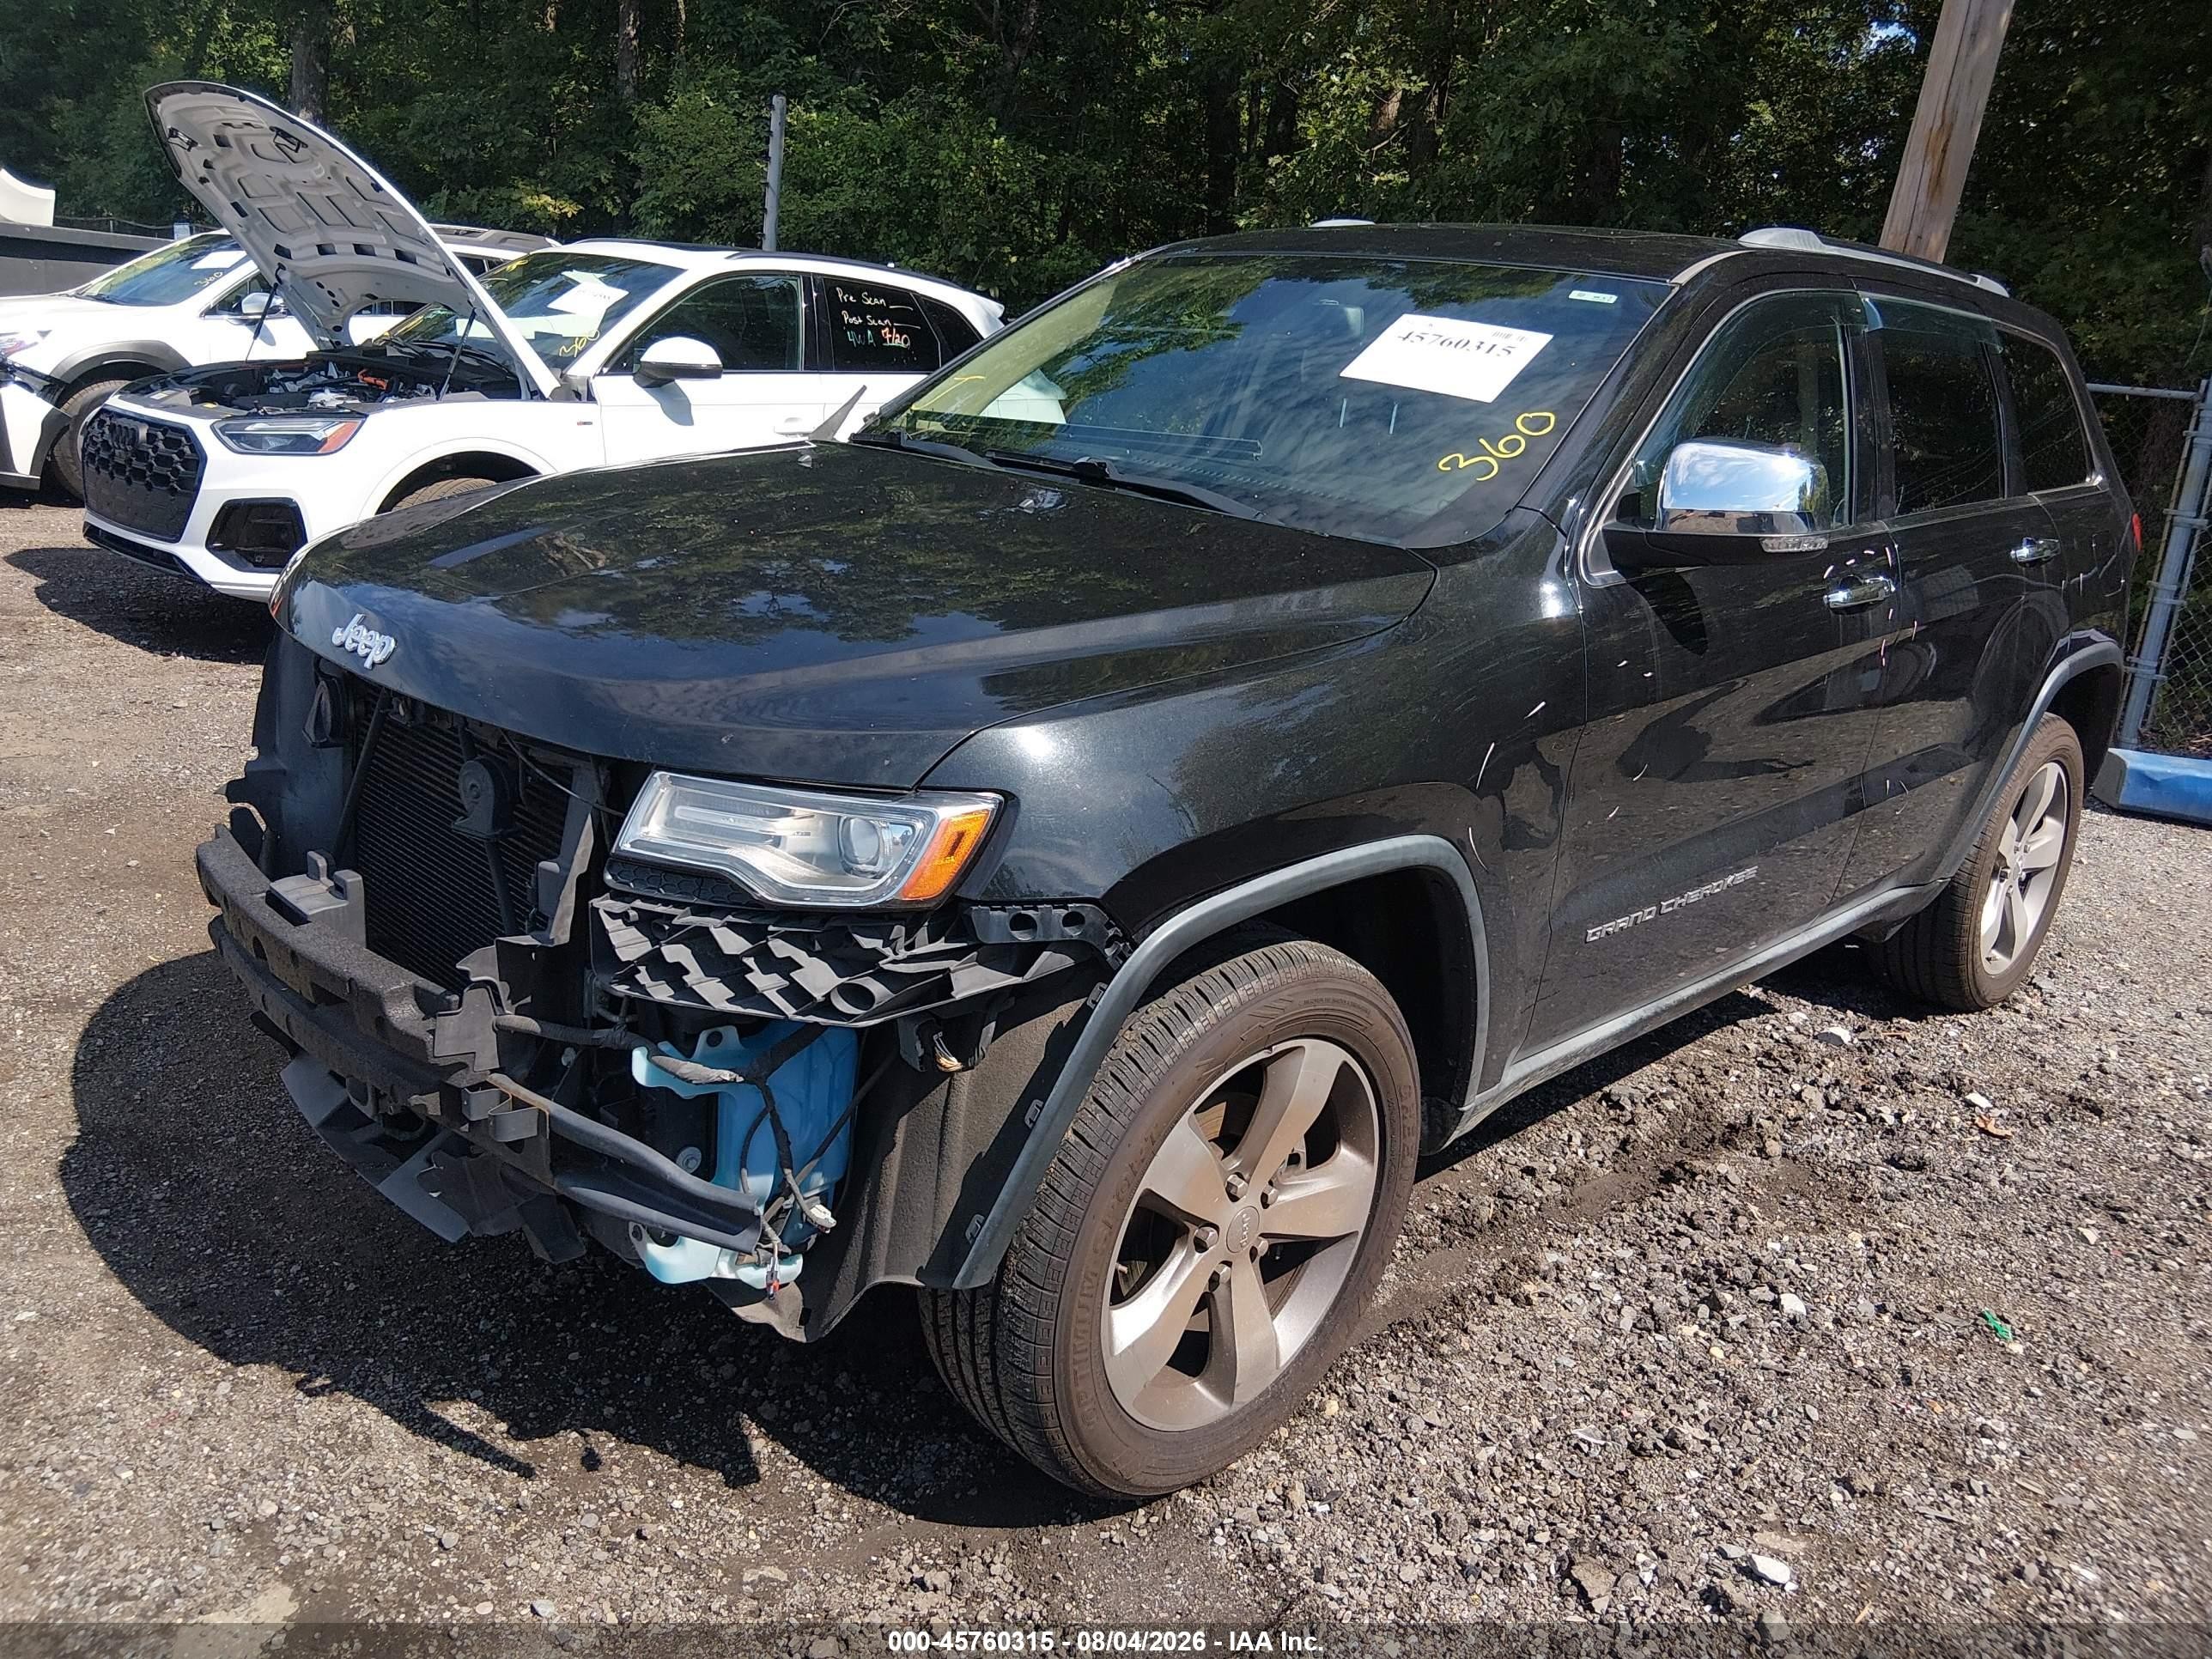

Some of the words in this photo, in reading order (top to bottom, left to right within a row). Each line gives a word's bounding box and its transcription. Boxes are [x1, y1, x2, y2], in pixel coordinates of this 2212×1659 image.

[836, 287, 857, 302] Pre
[861, 291, 887, 307] Scan
[841, 310, 864, 325] Post
[866, 314, 892, 326] Scan
[1397, 331, 1517, 356] 45760315
[1437, 411, 1556, 482] 360
[331, 613, 398, 670] Jeep
[1585, 906, 1657, 944] GRAND
[1660, 866, 1759, 915] CHEROKEE
